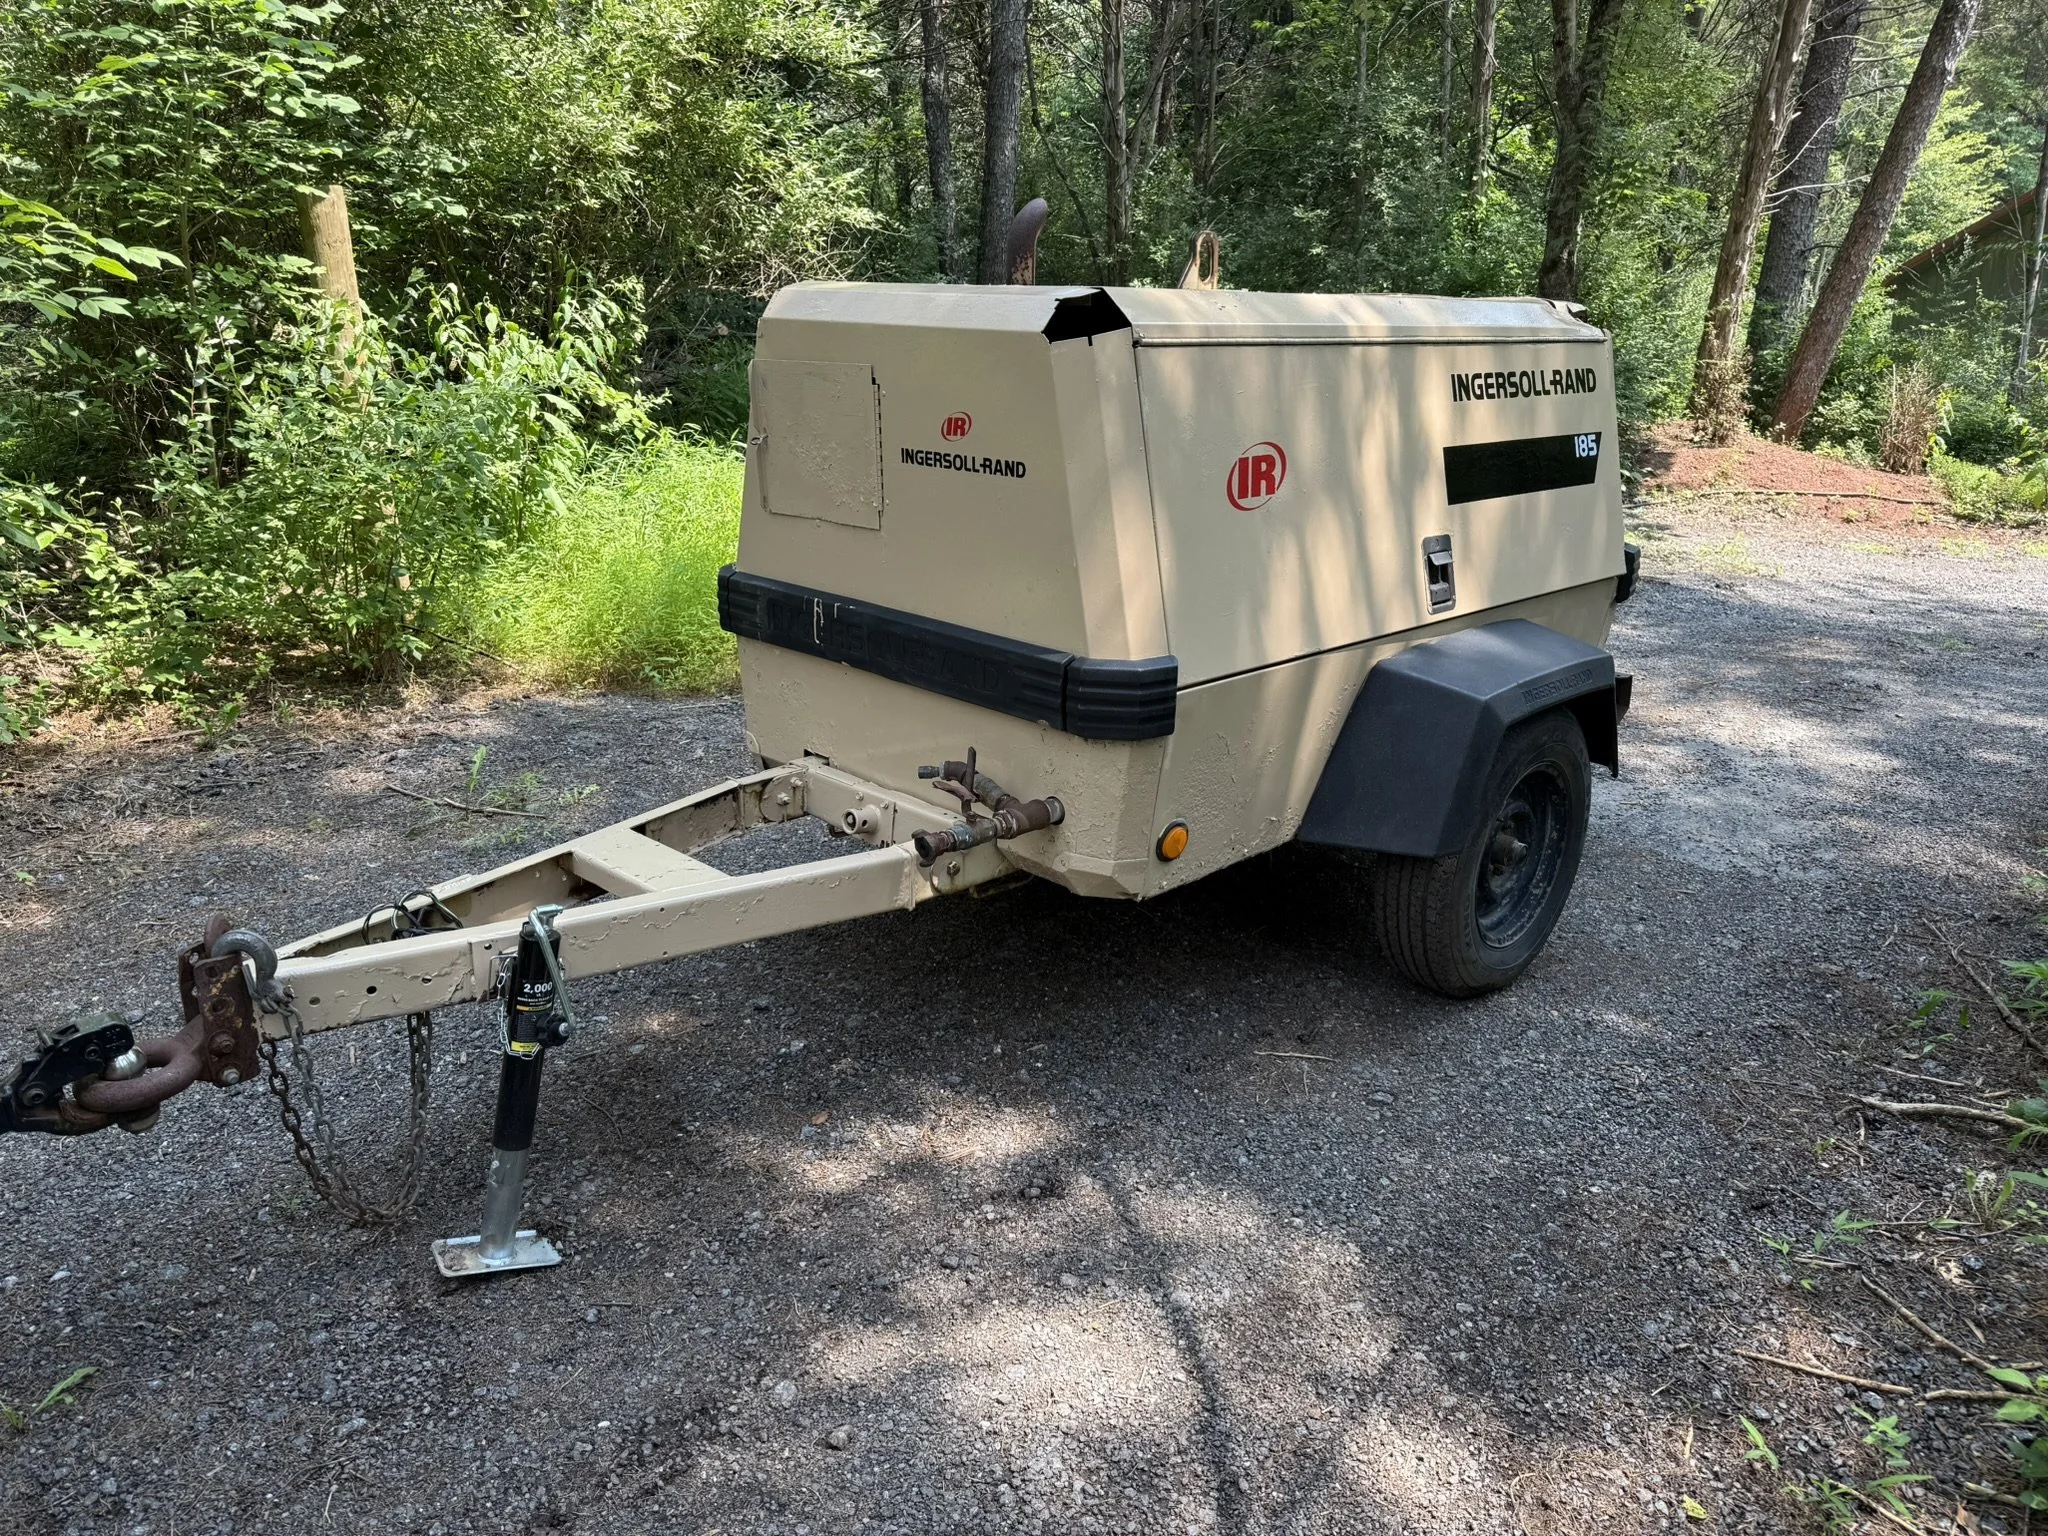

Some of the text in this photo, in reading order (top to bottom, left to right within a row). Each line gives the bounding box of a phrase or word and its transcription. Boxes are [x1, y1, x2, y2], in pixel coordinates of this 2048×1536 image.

[1450, 367, 1597, 402] INGERSOLL-RAND
[946, 416, 967, 437] IR
[1574, 434, 1598, 458] 185
[900, 447, 1026, 479] INGERSOLL-RAND
[1238, 454, 1276, 500] IR
[523, 981, 553, 994] 2,000
